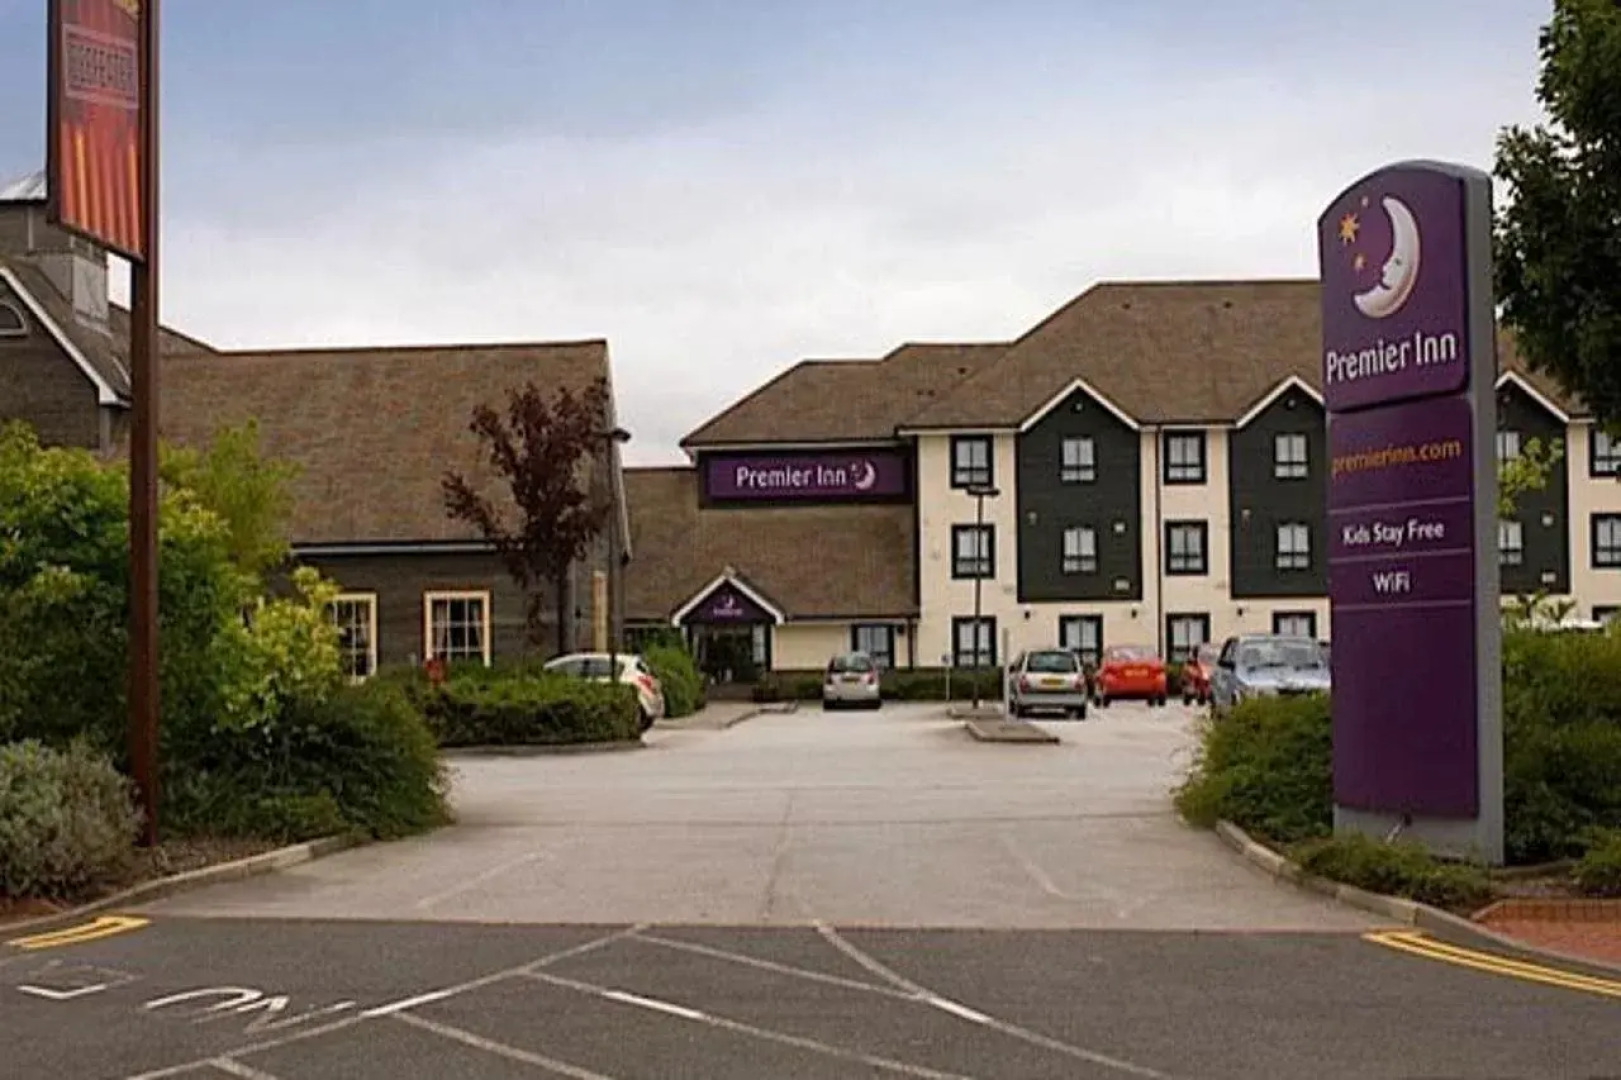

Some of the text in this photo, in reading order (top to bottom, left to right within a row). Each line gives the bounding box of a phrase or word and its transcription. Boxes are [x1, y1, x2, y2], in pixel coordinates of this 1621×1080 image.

[1327, 332, 1456, 385] Premier Inn
[1332, 440, 1461, 480] premierinn.com
[736, 464, 846, 488] Premier Inn
[1343, 518, 1444, 546] Kids Stay Free
[1373, 571, 1410, 592] WiFi
